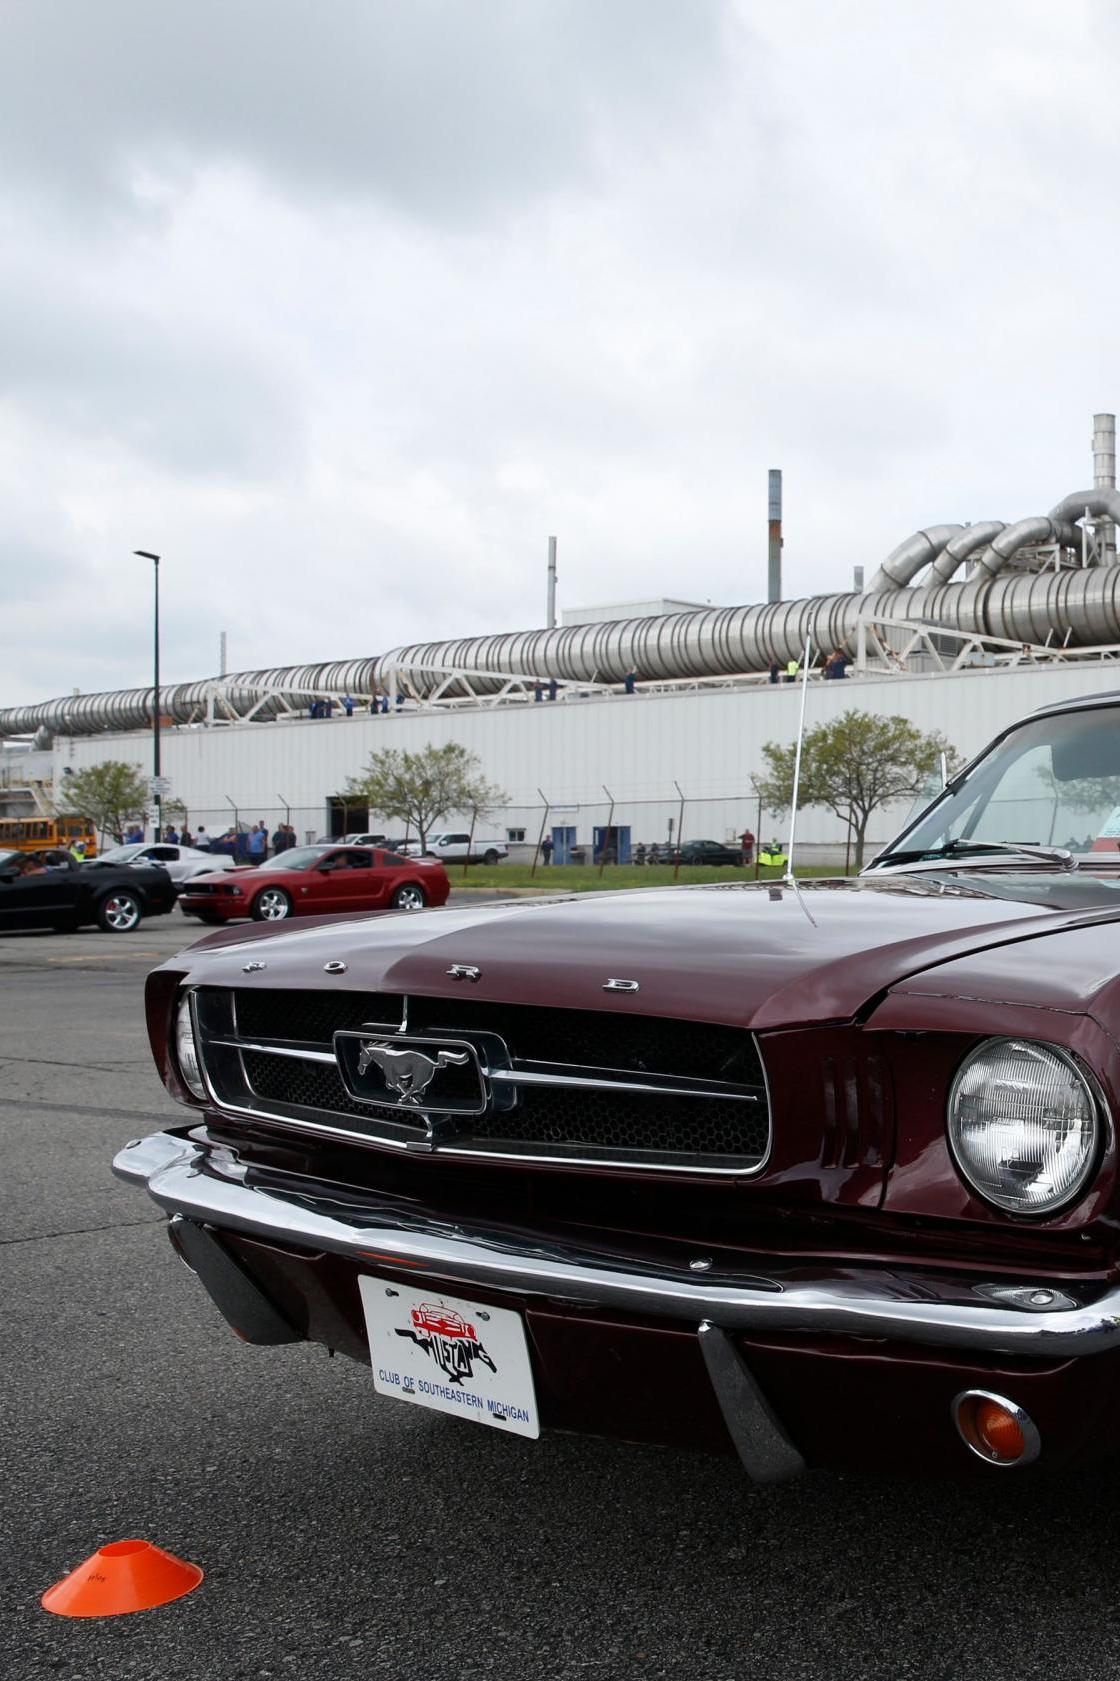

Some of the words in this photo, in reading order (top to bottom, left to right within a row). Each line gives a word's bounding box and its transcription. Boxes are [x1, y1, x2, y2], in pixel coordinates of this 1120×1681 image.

[242, 960, 641, 993] FORD
[414, 1334, 497, 1386] MUSTANG
[378, 1368, 400, 1386] CLUB
[403, 1375, 415, 1388] OF
[418, 1379, 483, 1409] SOUTHEASTERN
[487, 1399, 529, 1423] MICHIGAN
